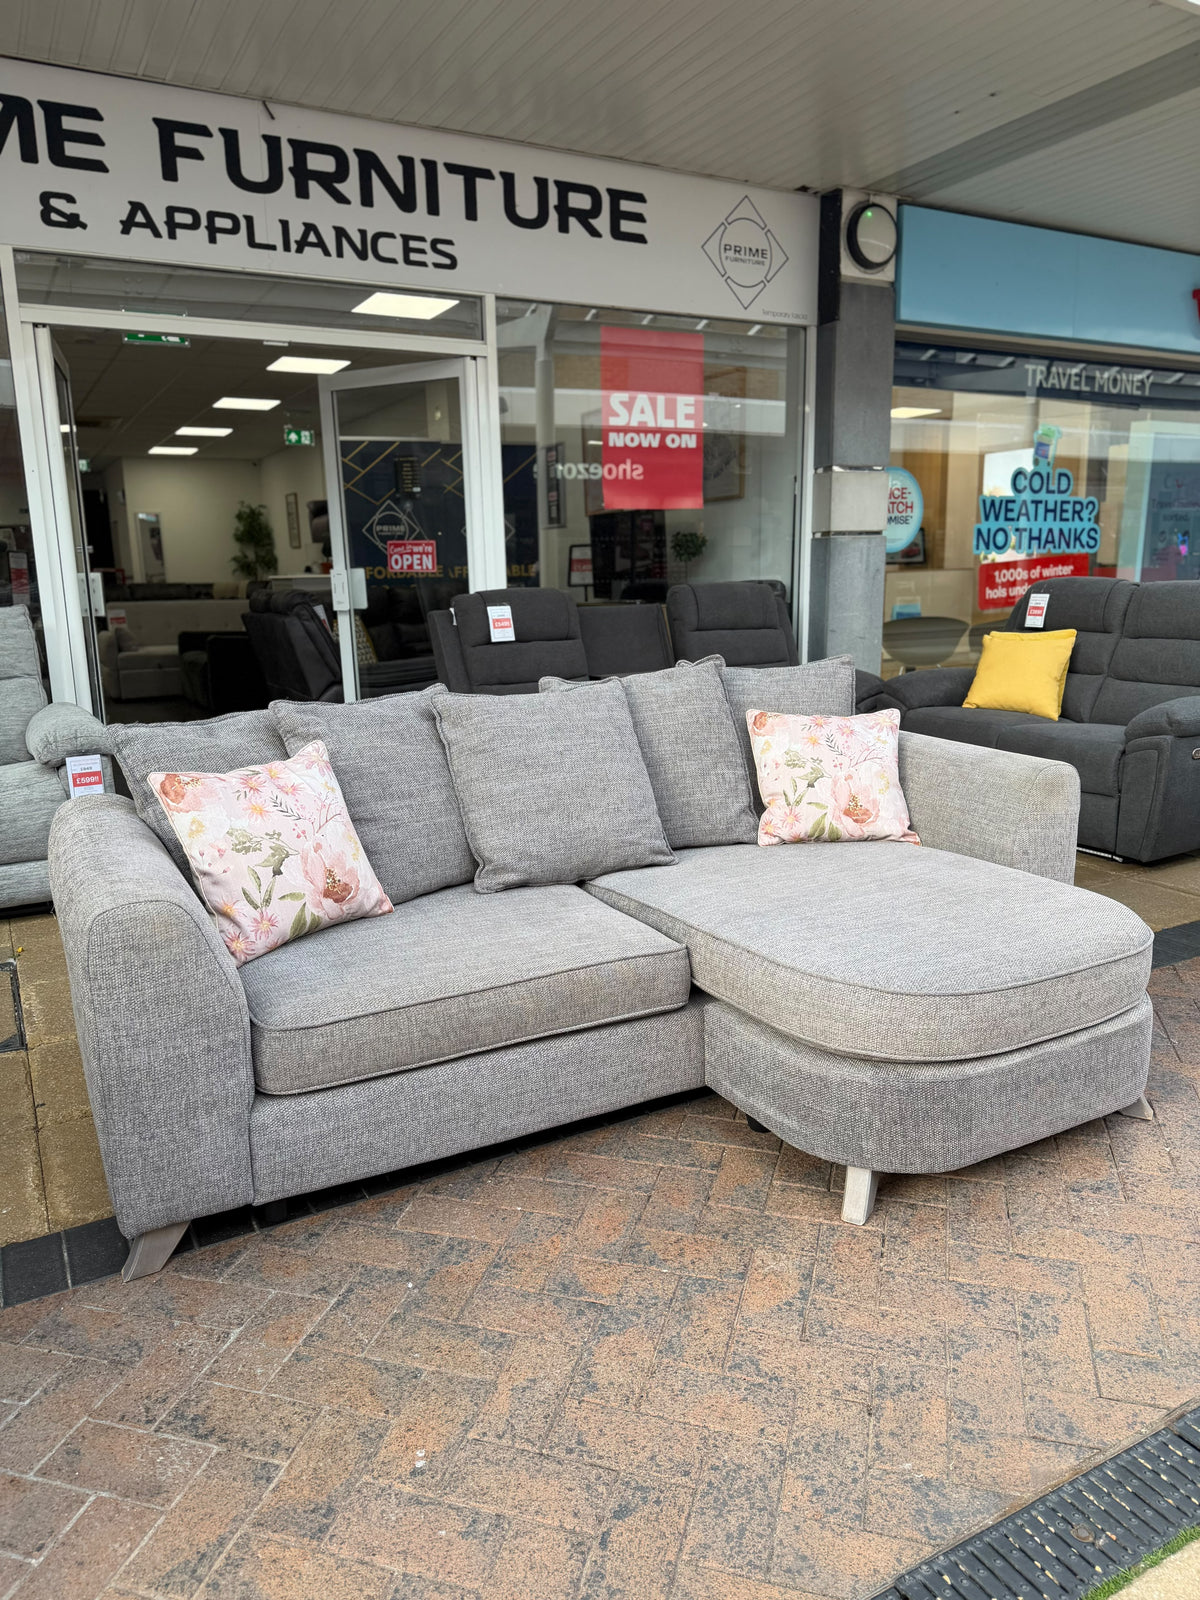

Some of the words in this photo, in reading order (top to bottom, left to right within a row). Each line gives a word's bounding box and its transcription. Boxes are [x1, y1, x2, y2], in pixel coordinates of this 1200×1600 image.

[152, 117, 648, 244] FURNITURE
[39, 190, 88, 230] &
[120, 201, 458, 270] APPLIANCES
[723, 243, 768, 259] PRIME
[725, 256, 765, 266] FURNITURE
[1025, 364, 1090, 391] TRAVEL
[1095, 371, 1154, 396] MONEY
[608, 393, 695, 428] SALE
[608, 432, 661, 447] NOW
[665, 433, 697, 448] ON
[1013, 470, 1072, 495] COLD
[888, 487, 912, 500] ICE-
[982, 498, 1096, 523] WEATHER?
[976, 527, 1009, 551] NO
[1014, 526, 1099, 550] THANKS
[391, 554, 433, 570] OPEN
[1030, 565, 1041, 579] of
[1042, 564, 1074, 578] winter
[985, 585, 1007, 600] hols
